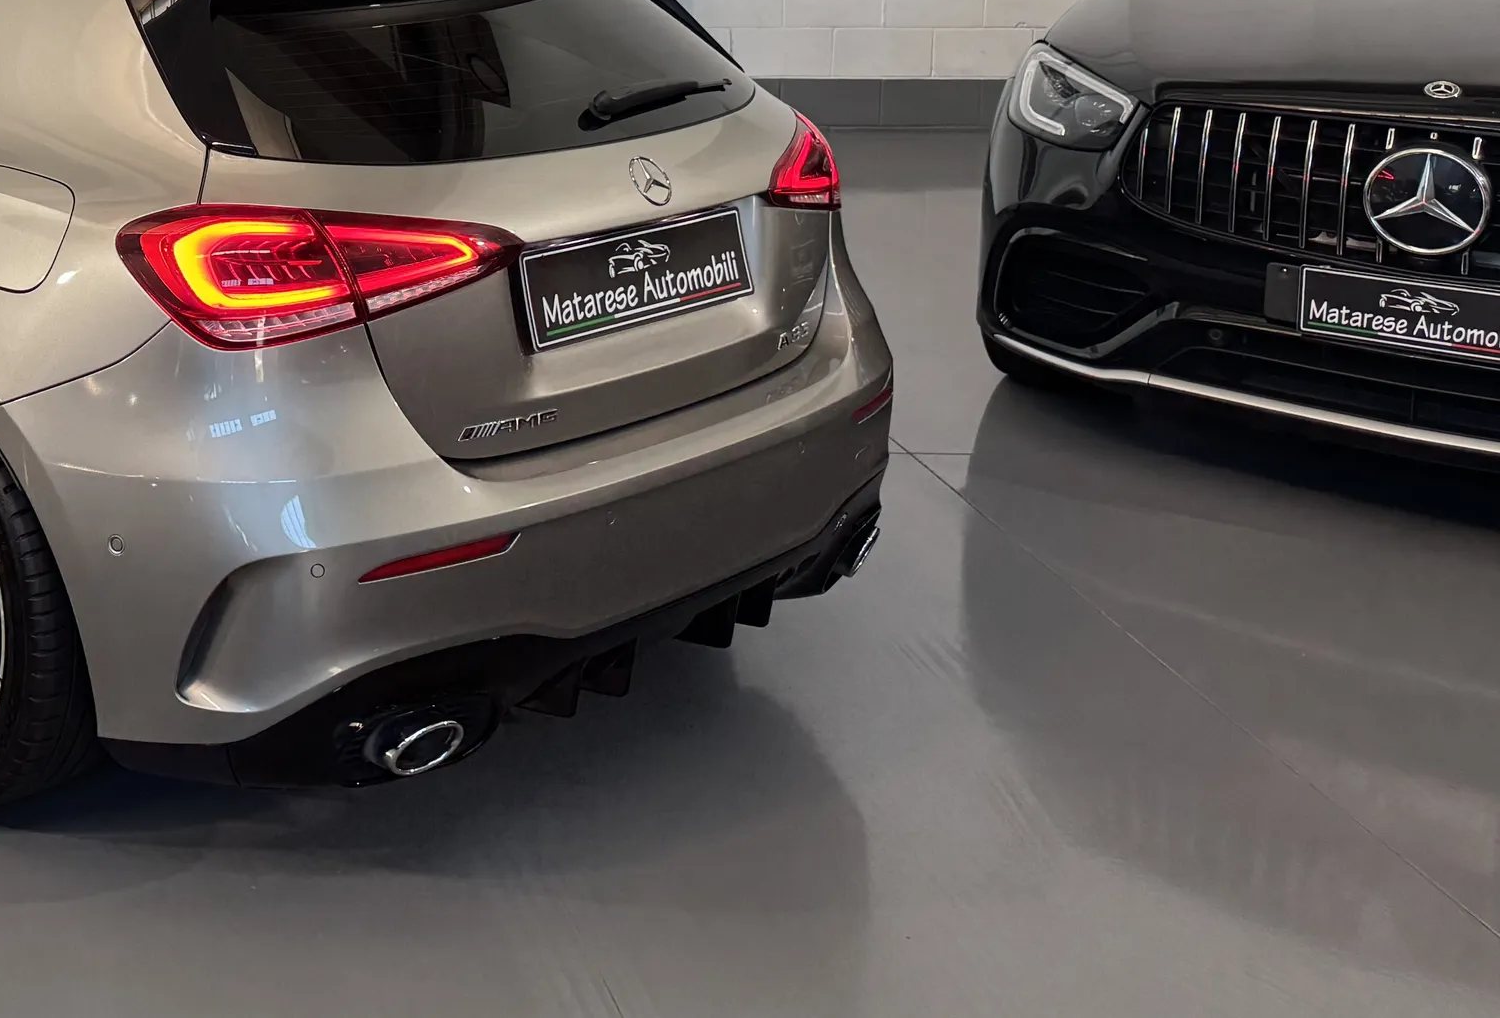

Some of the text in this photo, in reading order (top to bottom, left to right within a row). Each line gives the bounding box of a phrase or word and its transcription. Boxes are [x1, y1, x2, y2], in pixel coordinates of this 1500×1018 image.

[542, 250, 739, 329] Matarese Automobili
[1309, 299, 1500, 349] Matarese Automo
